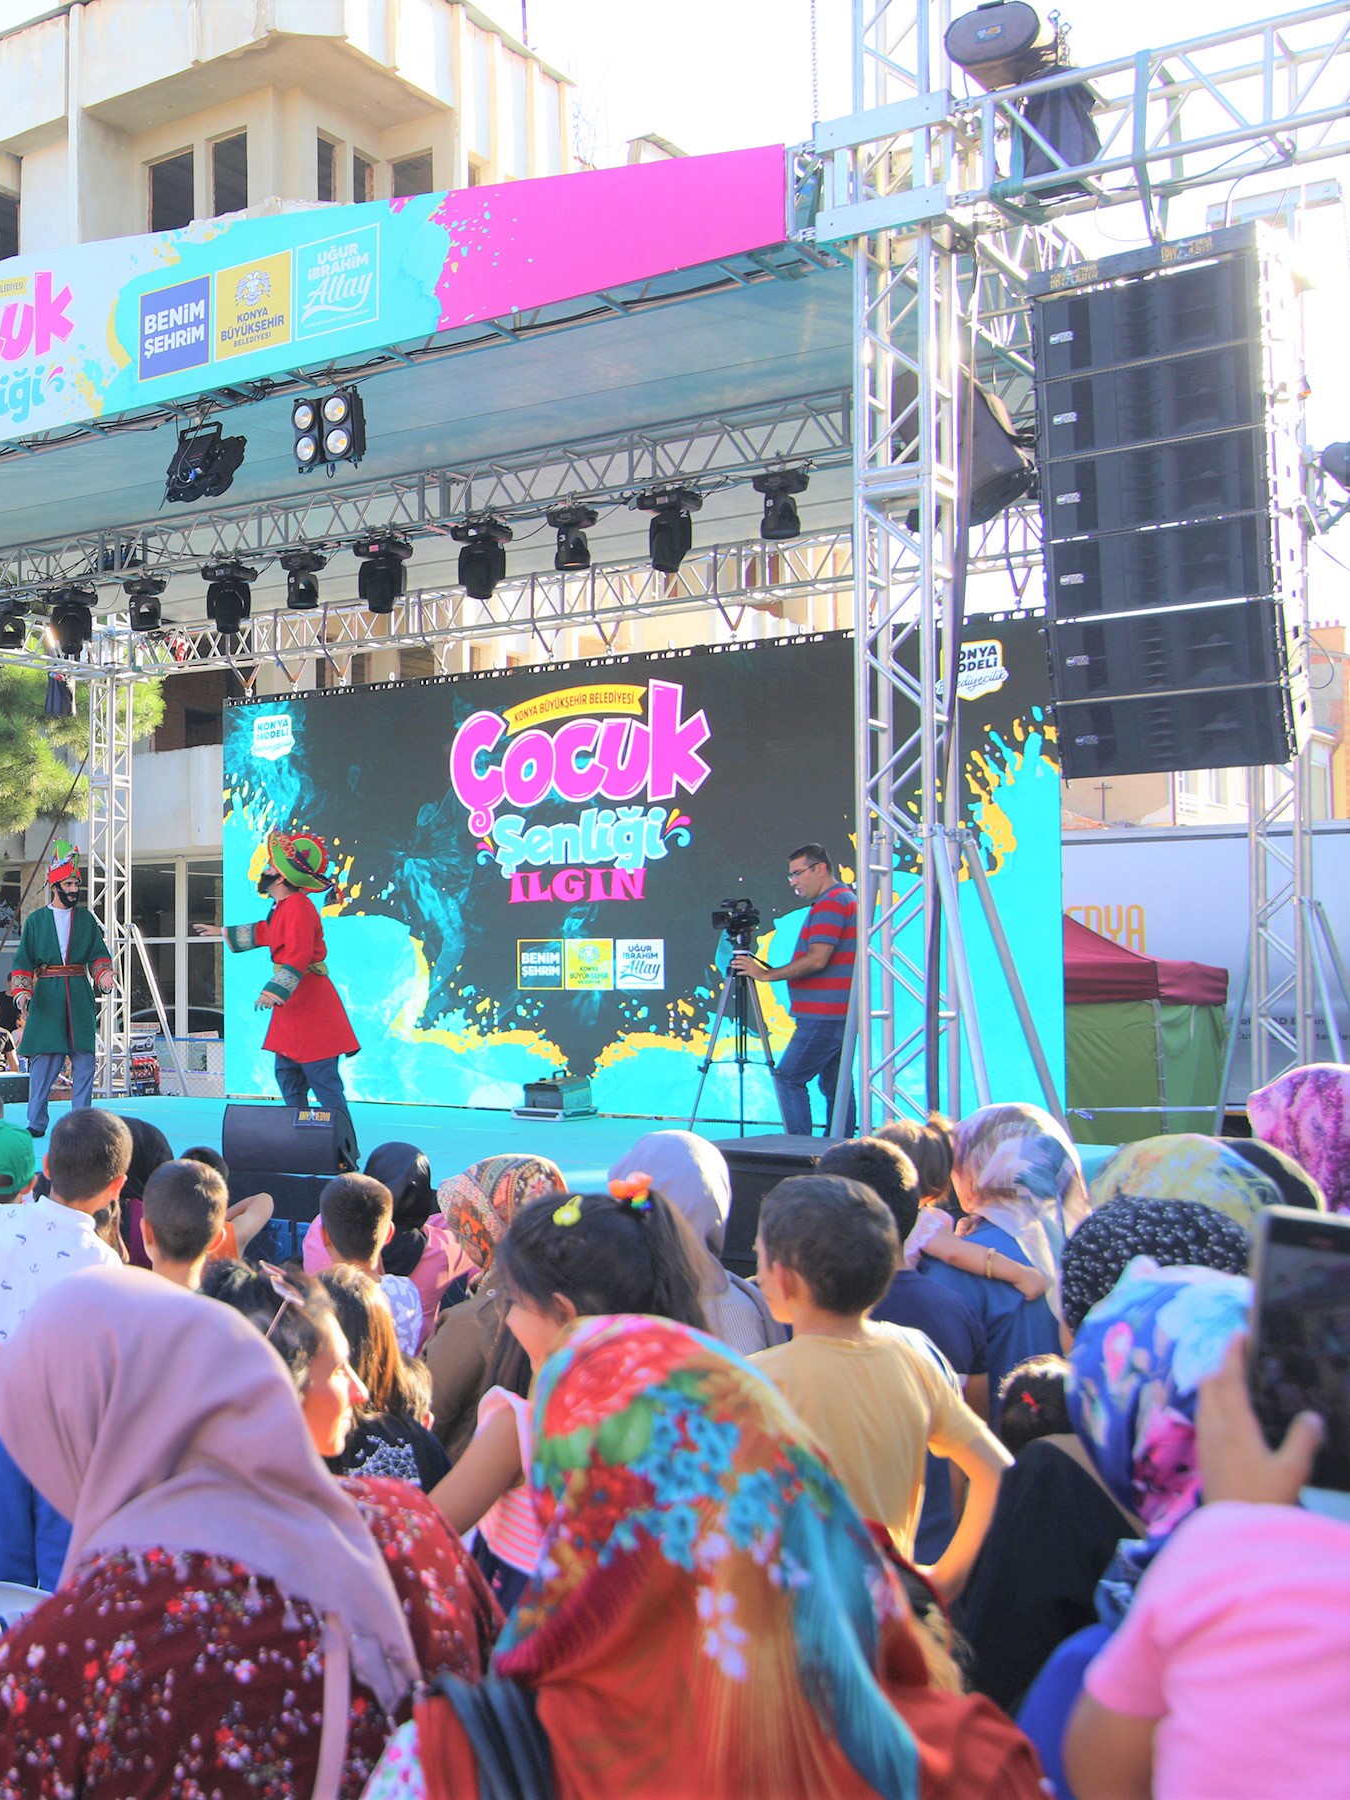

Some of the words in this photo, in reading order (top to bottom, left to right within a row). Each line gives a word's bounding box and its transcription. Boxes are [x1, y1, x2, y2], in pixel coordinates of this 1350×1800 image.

[317, 242, 359, 264] UĞUR
[301, 272, 374, 323] Altay
[236, 307, 268, 324] KONYA
[220, 314, 285, 342] BÜYÜKŞEHİR
[233, 331, 272, 348] BELEDİYESİ
[959, 645, 997, 660] ONYA
[958, 657, 998, 673] ODELİ
[514, 705, 538, 723] KONYA
[539, 693, 588, 713] BÜYÜKŞEHİR
[589, 691, 635, 705] BELEDİYESİ
[257, 719, 289, 731] KONYA
[450, 678, 712, 838] Çocuk
[492, 805, 669, 879] Şenliği
[508, 867, 647, 904] ILGIN
[628, 943, 652, 953] UĞUR
[619, 959, 661, 982] Altay
